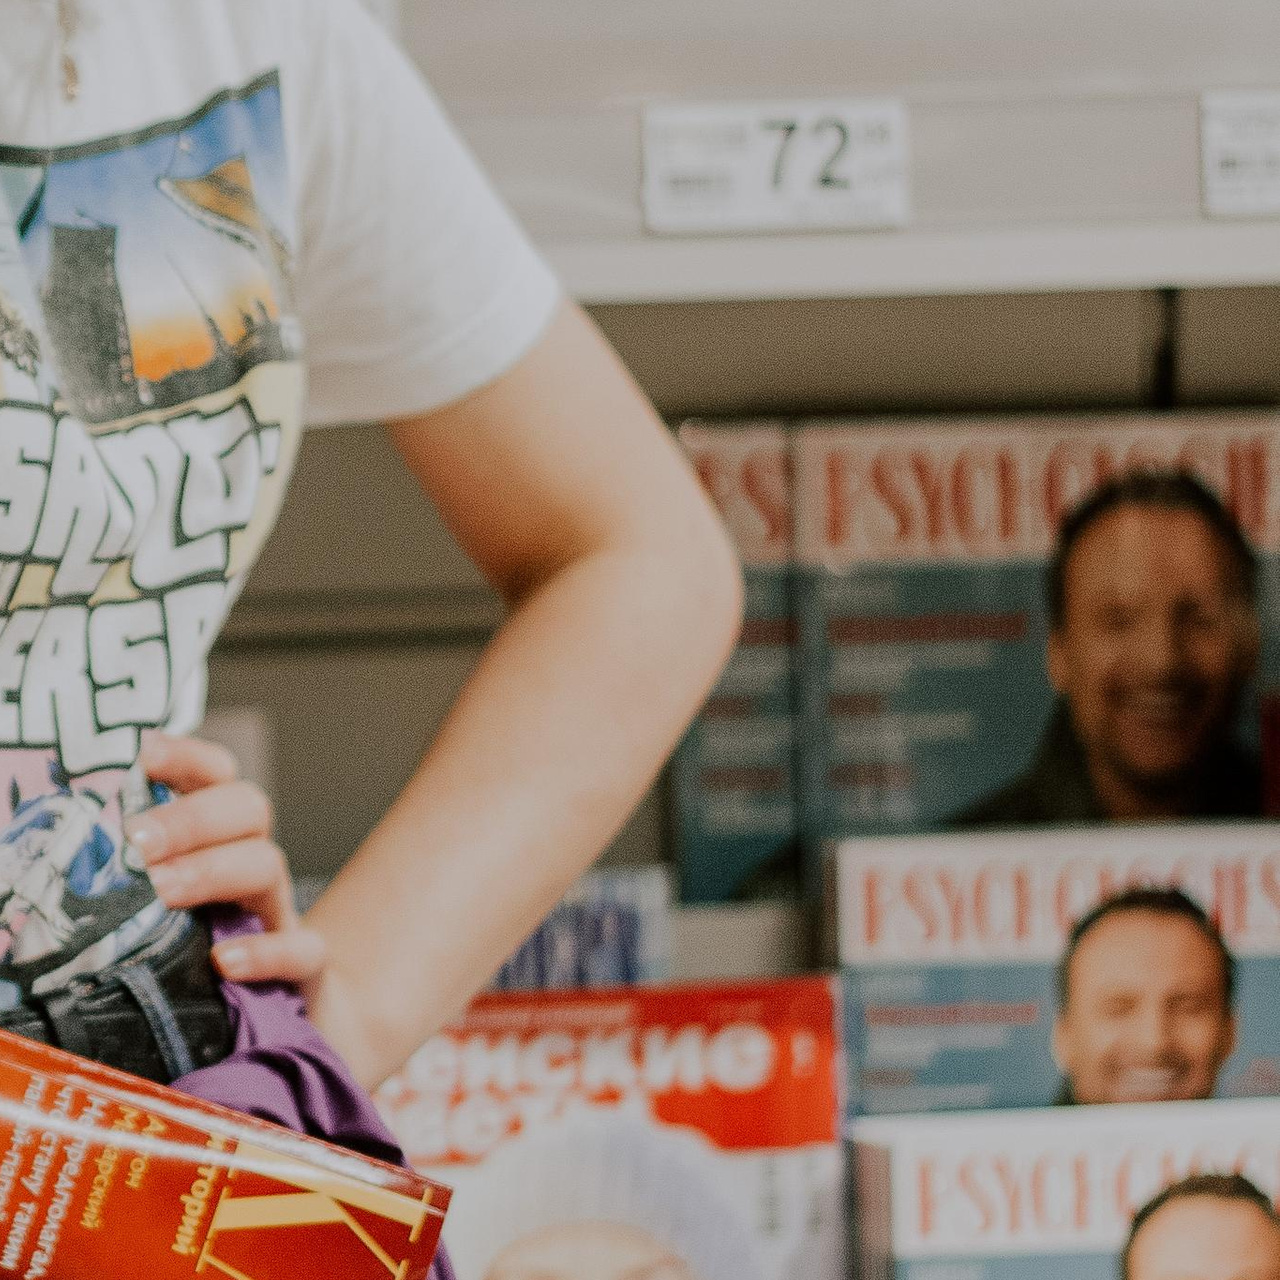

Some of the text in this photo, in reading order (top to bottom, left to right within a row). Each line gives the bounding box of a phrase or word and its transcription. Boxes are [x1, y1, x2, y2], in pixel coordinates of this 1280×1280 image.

[760, 119, 854, 192] 72
[20, 1129, 59, 1194] стану
[0, 1201, 37, 1270] таким
